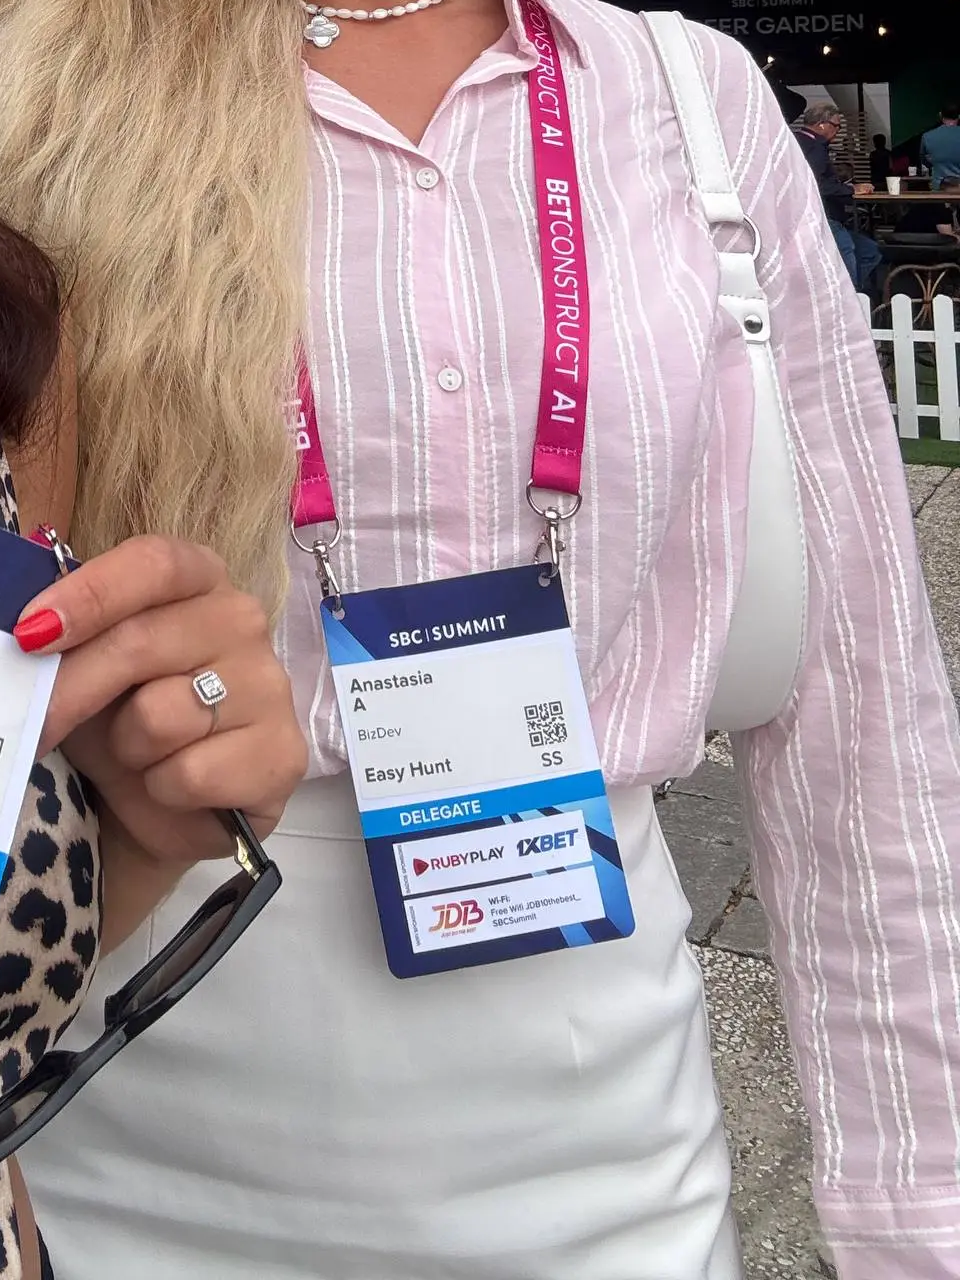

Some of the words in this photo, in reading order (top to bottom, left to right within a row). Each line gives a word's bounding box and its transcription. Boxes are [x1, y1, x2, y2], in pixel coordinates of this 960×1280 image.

[756, 13, 864, 34] GARDEN
[541, 122, 564, 147] AI
[545, 177, 580, 383] BETCONSTRUCT
[551, 388, 576, 423] AI
[389, 628, 423, 648] SBC
[432, 614, 507, 641] SUMMIT
[350, 670, 433, 694] Anastasia
[353, 698, 367, 713] A
[358, 725, 402, 742] BizDev
[365, 765, 405, 784] Easy
[410, 757, 453, 777] Hunt
[541, 751, 563, 767] SS
[399, 799, 482, 827] DELEGATE
[431, 846, 505, 870] RUBYPLAY
[516, 828, 579, 858] 1XBET
[428, 899, 484, 933] JDB
[491, 907, 508, 918] Free
